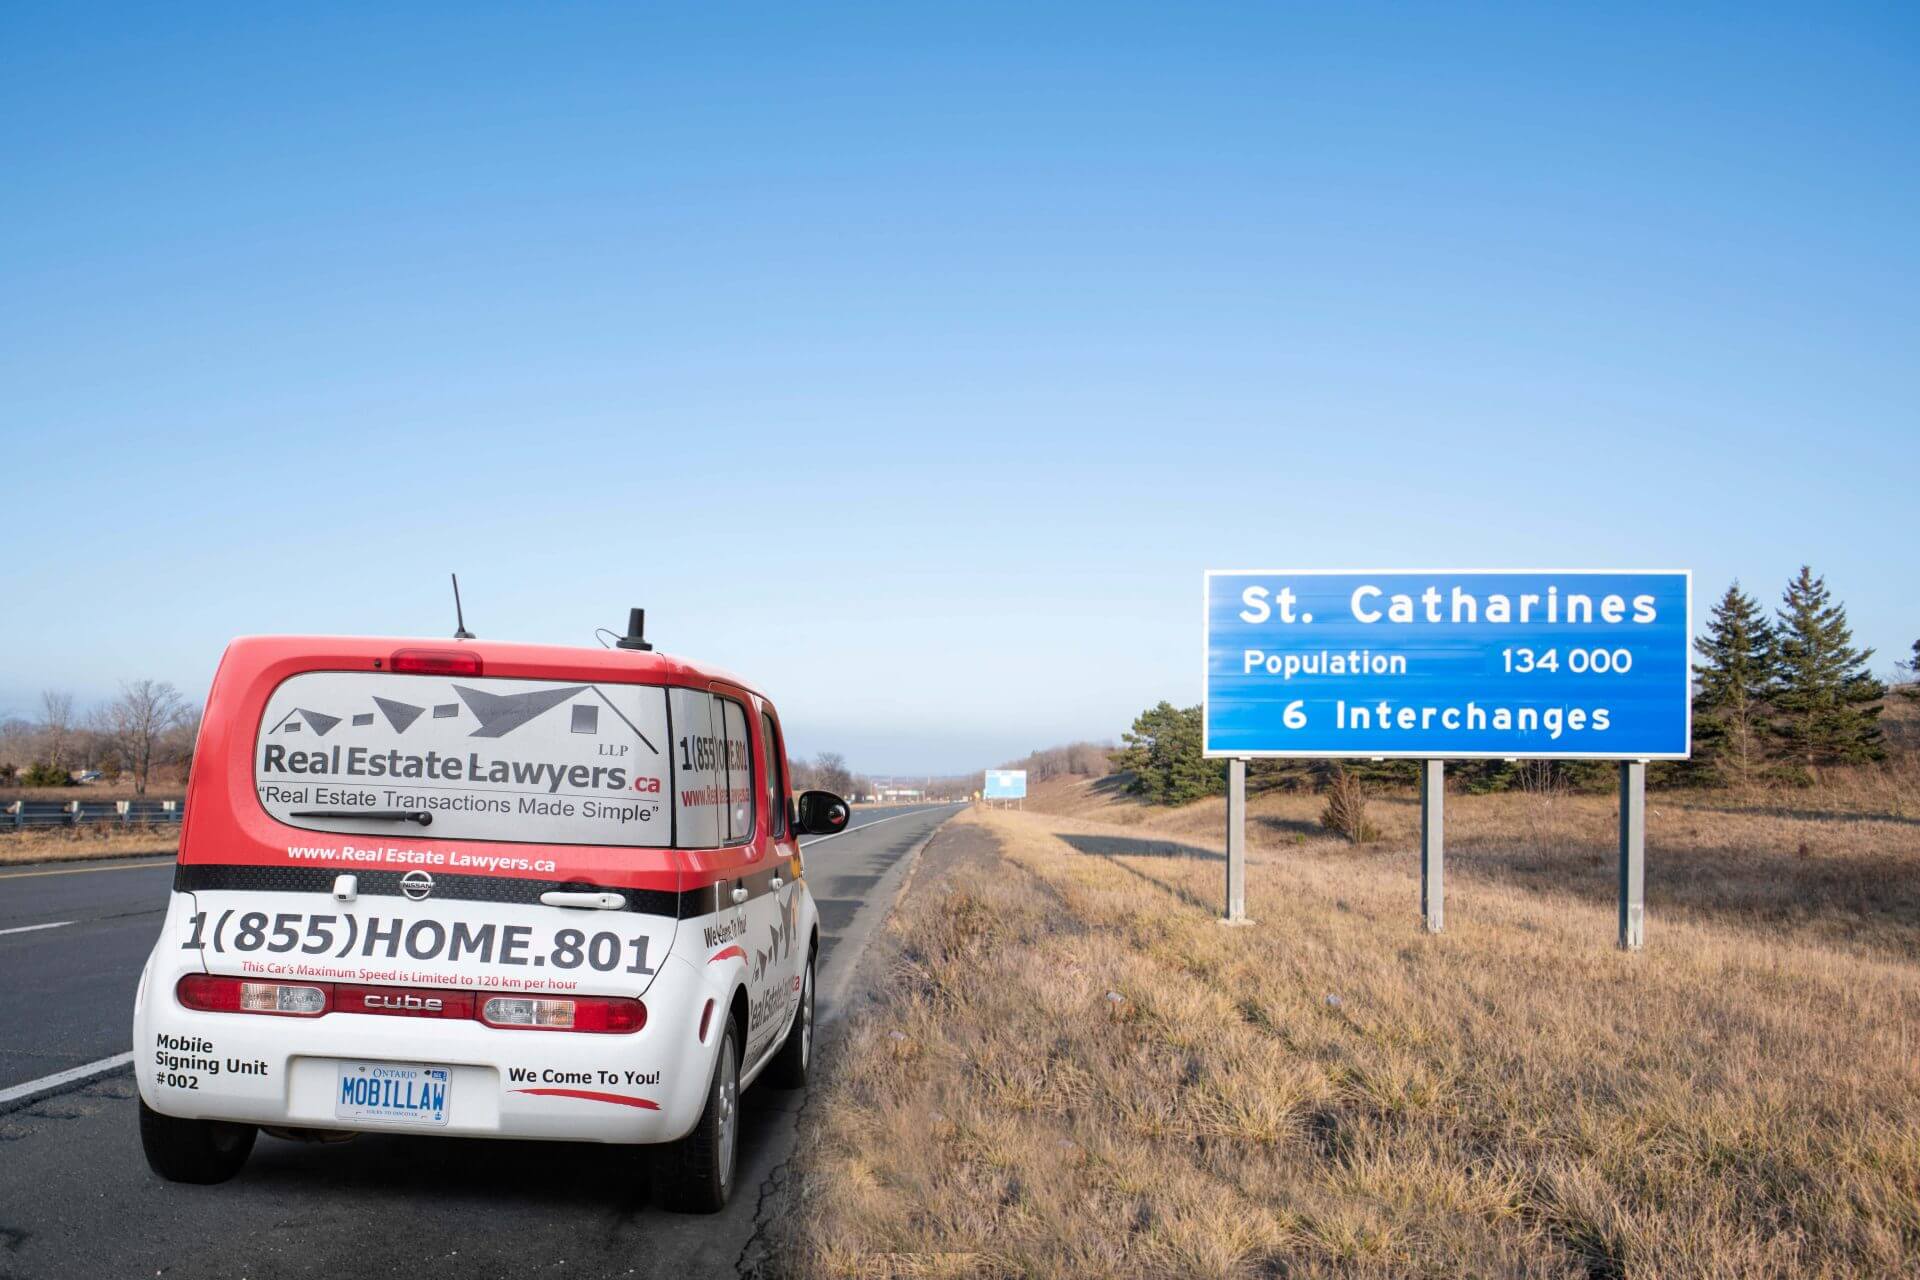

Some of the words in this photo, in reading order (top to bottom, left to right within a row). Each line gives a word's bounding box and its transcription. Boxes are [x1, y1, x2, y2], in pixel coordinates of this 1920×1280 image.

[1239, 586, 1313, 624] St.
[1351, 585, 1657, 624] Catharines
[1244, 649, 1407, 679] Population
[1503, 649, 1559, 673] 134
[1568, 649, 1632, 674] 000
[1283, 700, 1307, 730] 6
[1337, 700, 1611, 740] Interchanges
[598, 744, 629, 757] LLP
[316, 788, 377, 807] Estate
[383, 790, 511, 813] Transactions
[518, 797, 575, 817] Made
[181, 909, 655, 976] 1(855)HOME.801
[704, 927, 717, 948] We
[242, 961, 264, 973] This
[297, 965, 356, 980] Maximum
[359, 969, 396, 982] Speed
[399, 971, 408, 982] is
[411, 972, 457, 985] Limited
[460, 976, 473, 986] to
[477, 976, 499, 987] 120
[502, 978, 521, 988] km
[524, 980, 545, 991] per
[548, 979, 577, 990] hour
[364, 994, 443, 1010] cube
[156, 1033, 213, 1053] Mobile
[155, 1050, 219, 1075] Signing
[226, 1058, 268, 1076] Unit
[508, 1067, 537, 1082] We
[542, 1069, 592, 1084] Come
[597, 1070, 618, 1085] To
[624, 1070, 660, 1085] You!
[156, 1071, 199, 1089] #002
[342, 1076, 446, 1111] MOBILLAW
